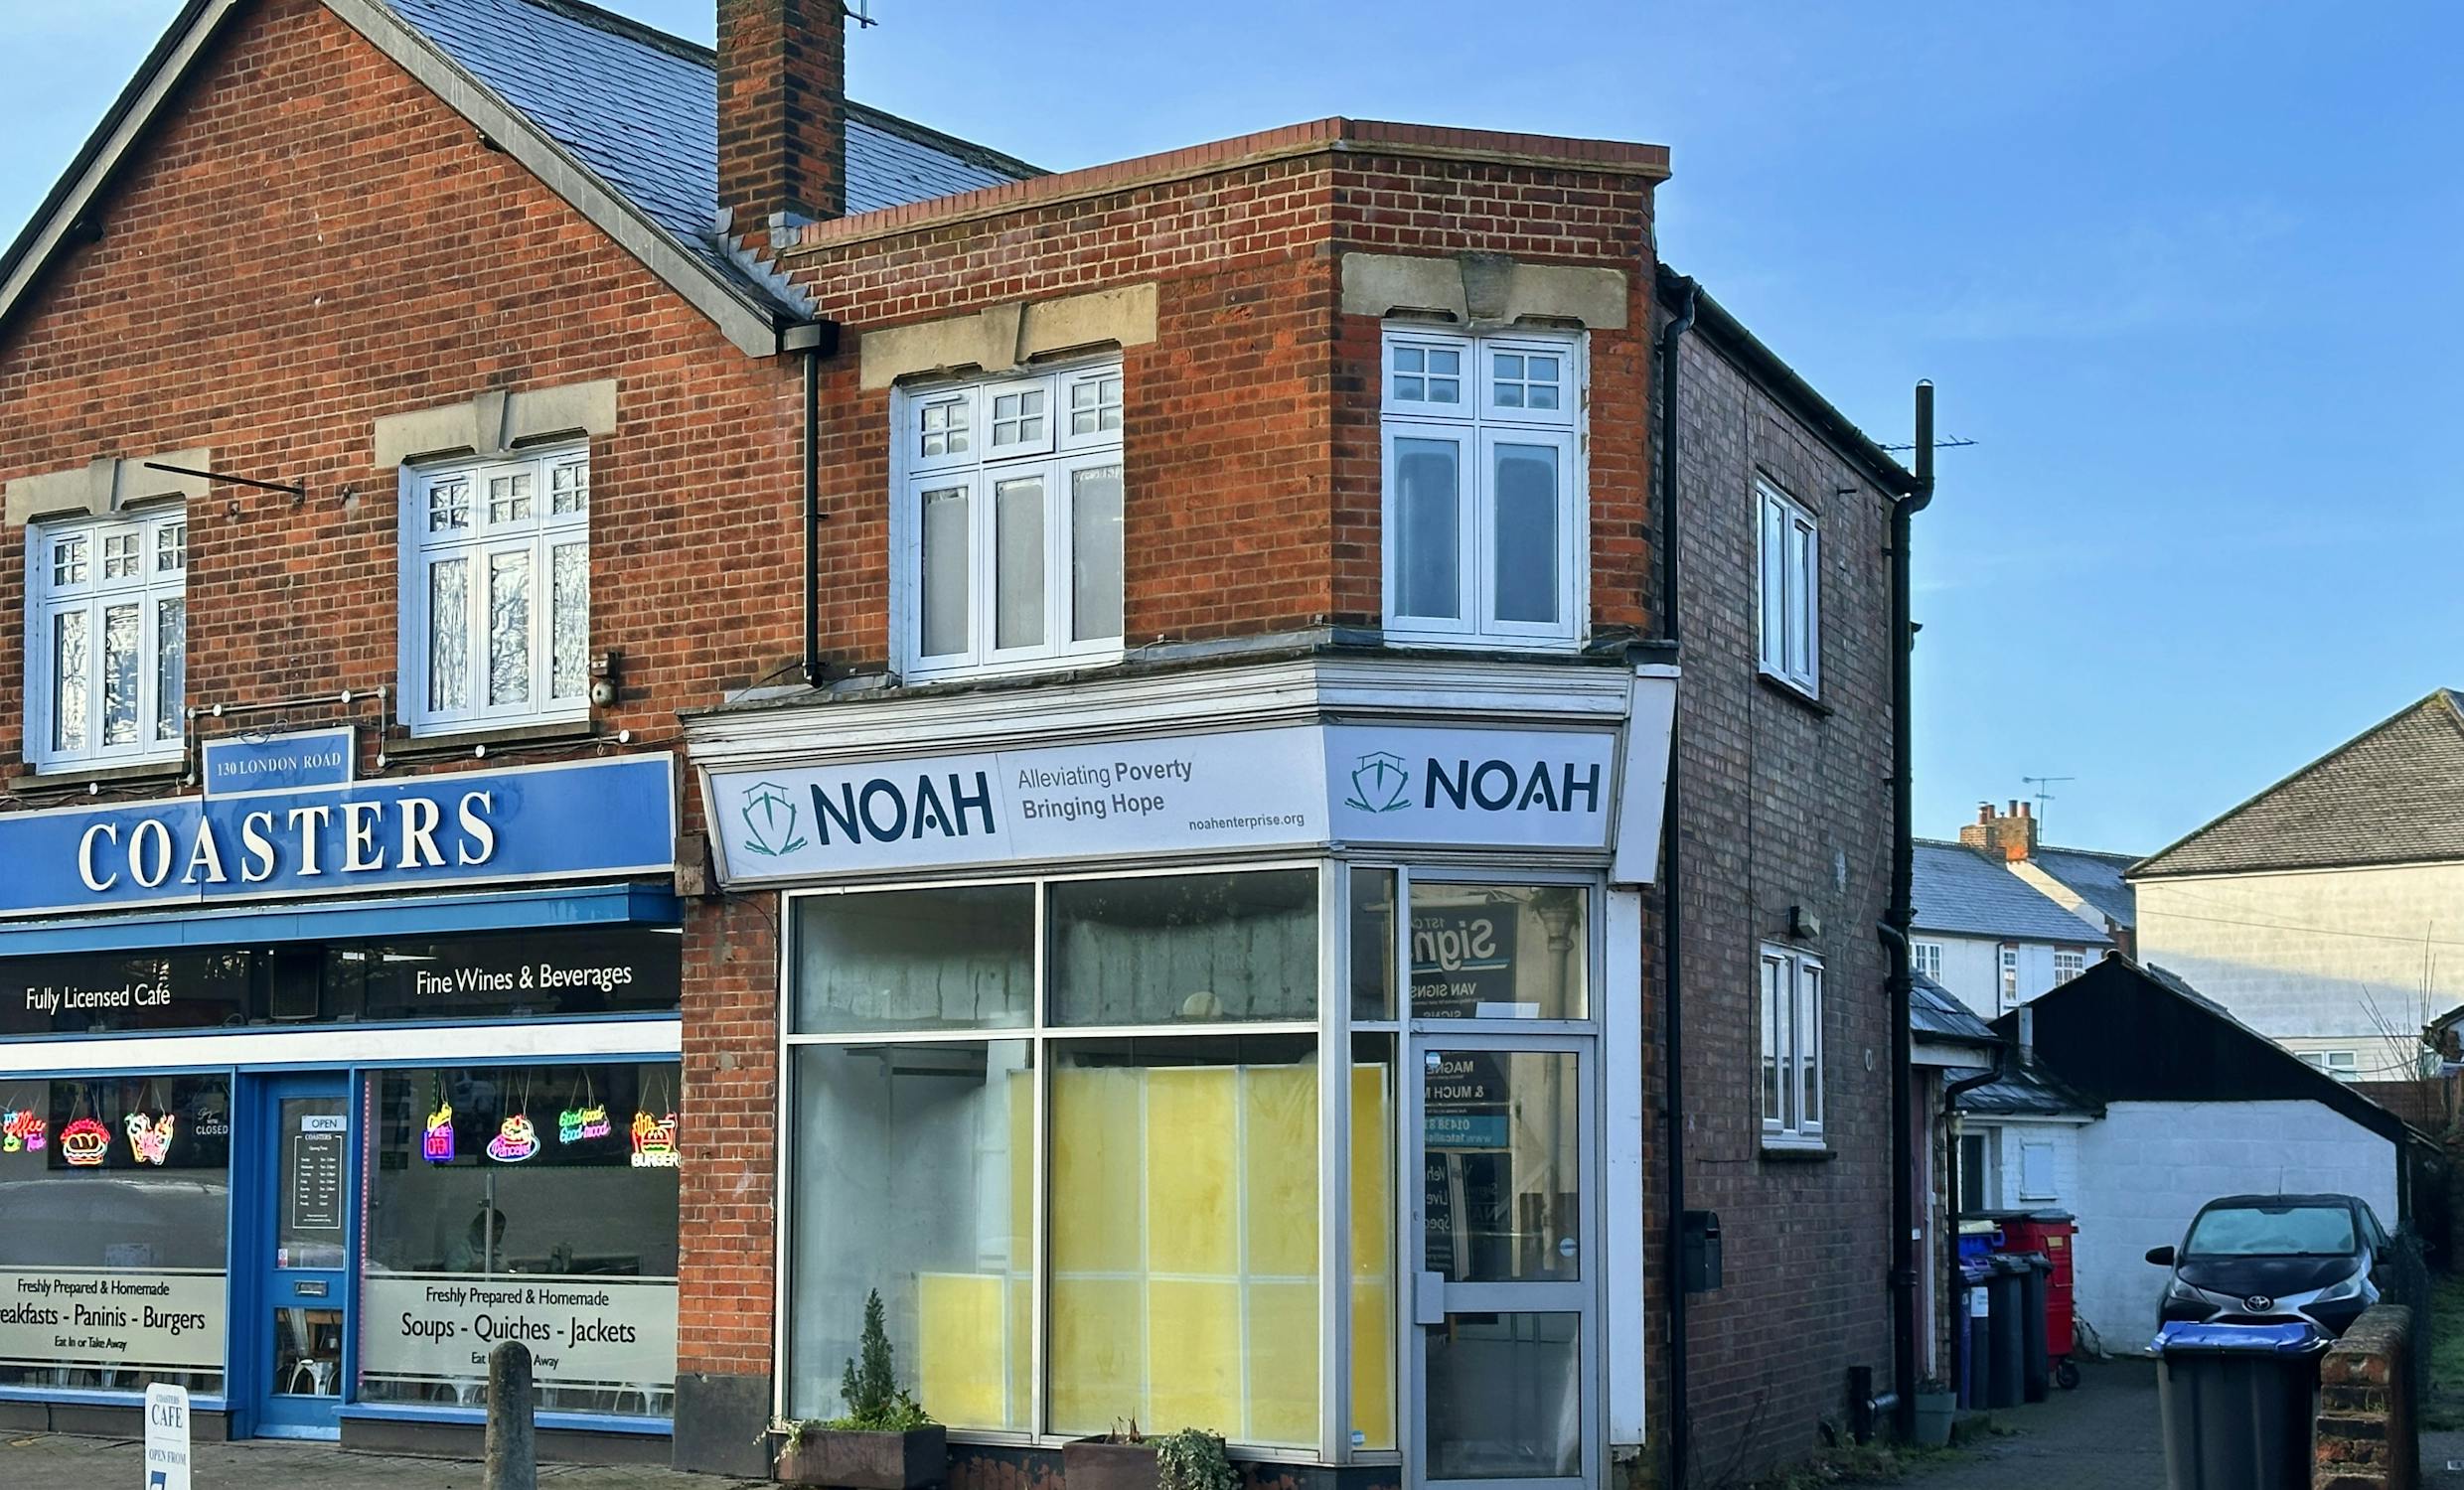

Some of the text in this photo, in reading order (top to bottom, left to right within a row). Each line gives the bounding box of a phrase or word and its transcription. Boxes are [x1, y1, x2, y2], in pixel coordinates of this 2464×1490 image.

[217, 752, 341, 777] 130 LONDON ROAD
[1018, 759, 1193, 790] Alleviating Poverty
[1425, 757, 1601, 813] NOAH
[810, 770, 997, 846] NOAH
[1021, 793, 1165, 821] Bringing Hope
[1189, 813, 1306, 831] noahenterprise.org
[77, 791, 496, 892] COASTERS
[416, 964, 632, 994] Fine Wines & Beverages
[26, 981, 171, 1015] Fully Licensed Café
[196, 1124, 229, 1135] CLOSED
[311, 1118, 338, 1128] OPEN
[630, 1151, 681, 1168] BURGER
[18, 1278, 170, 1297] Freshly Prepared & Homemade
[426, 1286, 610, 1307] Freshly Prepared & Homemade
[0, 1302, 58, 1325] eakfasts
[75, 1303, 127, 1327] Paninis
[143, 1305, 206, 1336] Burgers
[401, 1312, 455, 1344] Soups
[474, 1313, 550, 1342] Quiches
[568, 1316, 637, 1348] Jackets
[55, 1336, 128, 1353] Eat In or Take Away
[471, 1351, 486, 1364] Eat
[534, 1353, 559, 1370] Away
[151, 1404, 183, 1428] CAFE
[148, 1448, 187, 1466] OPEN FROM
